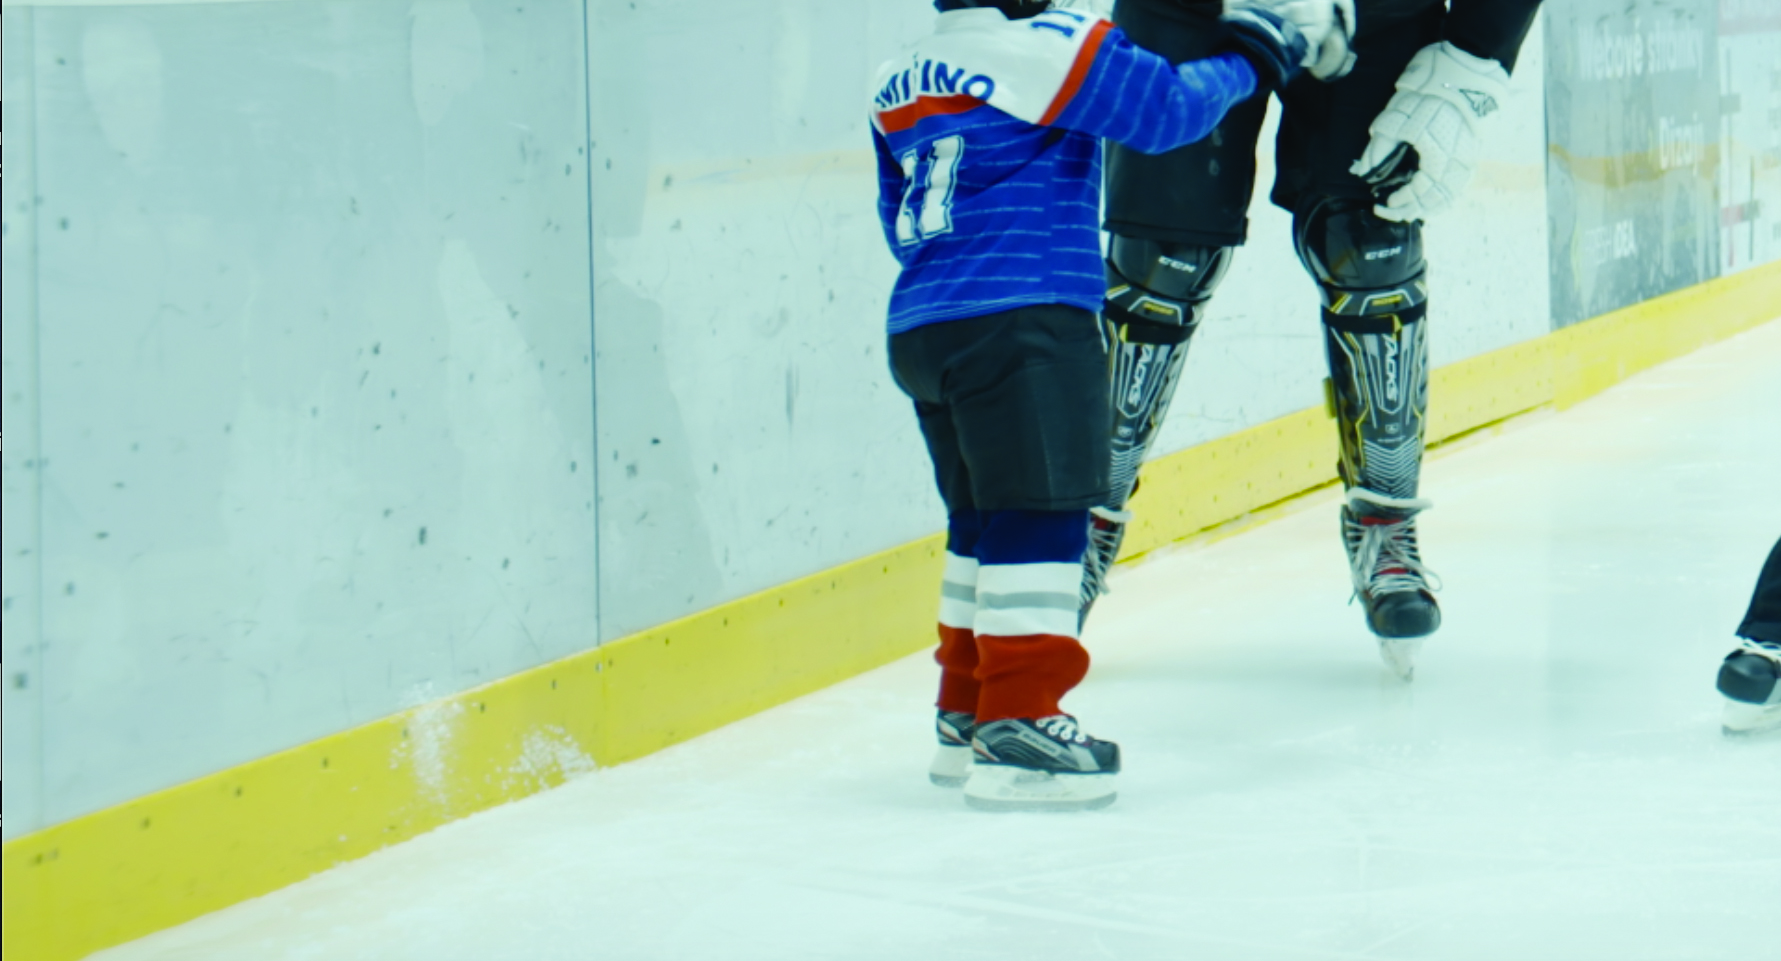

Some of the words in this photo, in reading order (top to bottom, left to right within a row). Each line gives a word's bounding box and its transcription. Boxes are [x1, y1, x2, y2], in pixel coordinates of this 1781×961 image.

[896, 134, 965, 246] 11
[1157, 254, 1197, 275] CCM
[1363, 245, 1403, 261] CCM
[1127, 344, 1155, 406] ACKS
